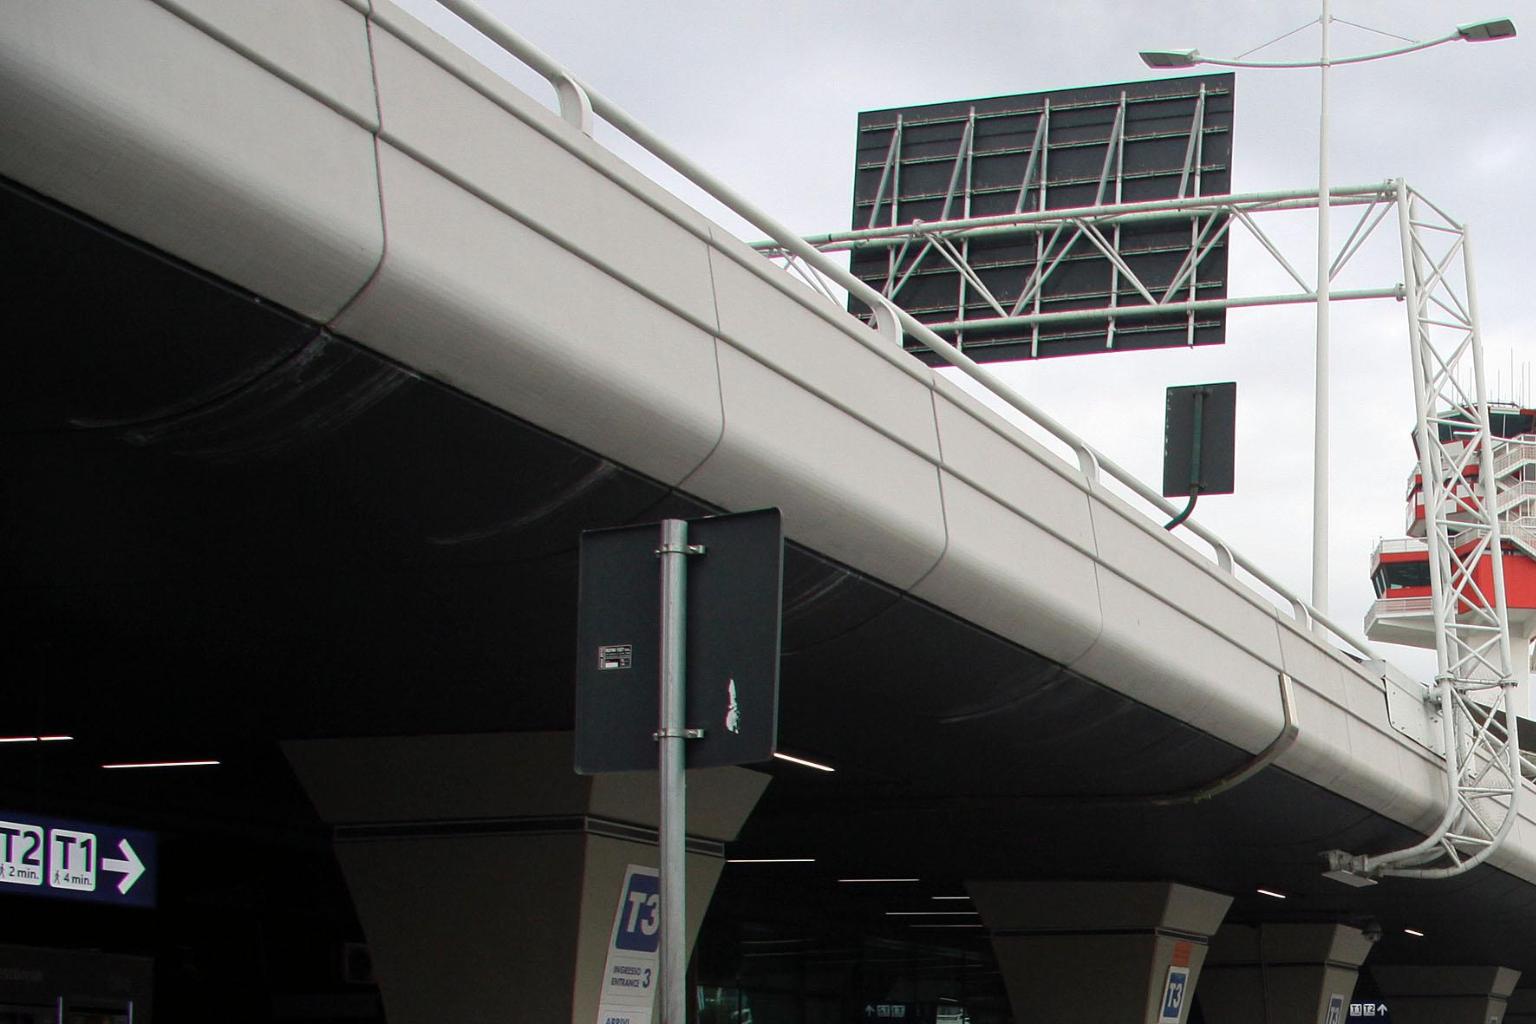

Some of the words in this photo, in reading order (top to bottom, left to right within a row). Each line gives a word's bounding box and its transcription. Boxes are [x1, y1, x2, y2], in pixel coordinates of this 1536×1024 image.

[0, 827, 41, 866] T2
[55, 834, 92, 873] T1
[9, 866, 16, 877] 2
[63, 873, 70, 882] 4
[626, 891, 660, 936] T3
[642, 968, 652, 989] 3
[1167, 982, 1183, 1009] T3
